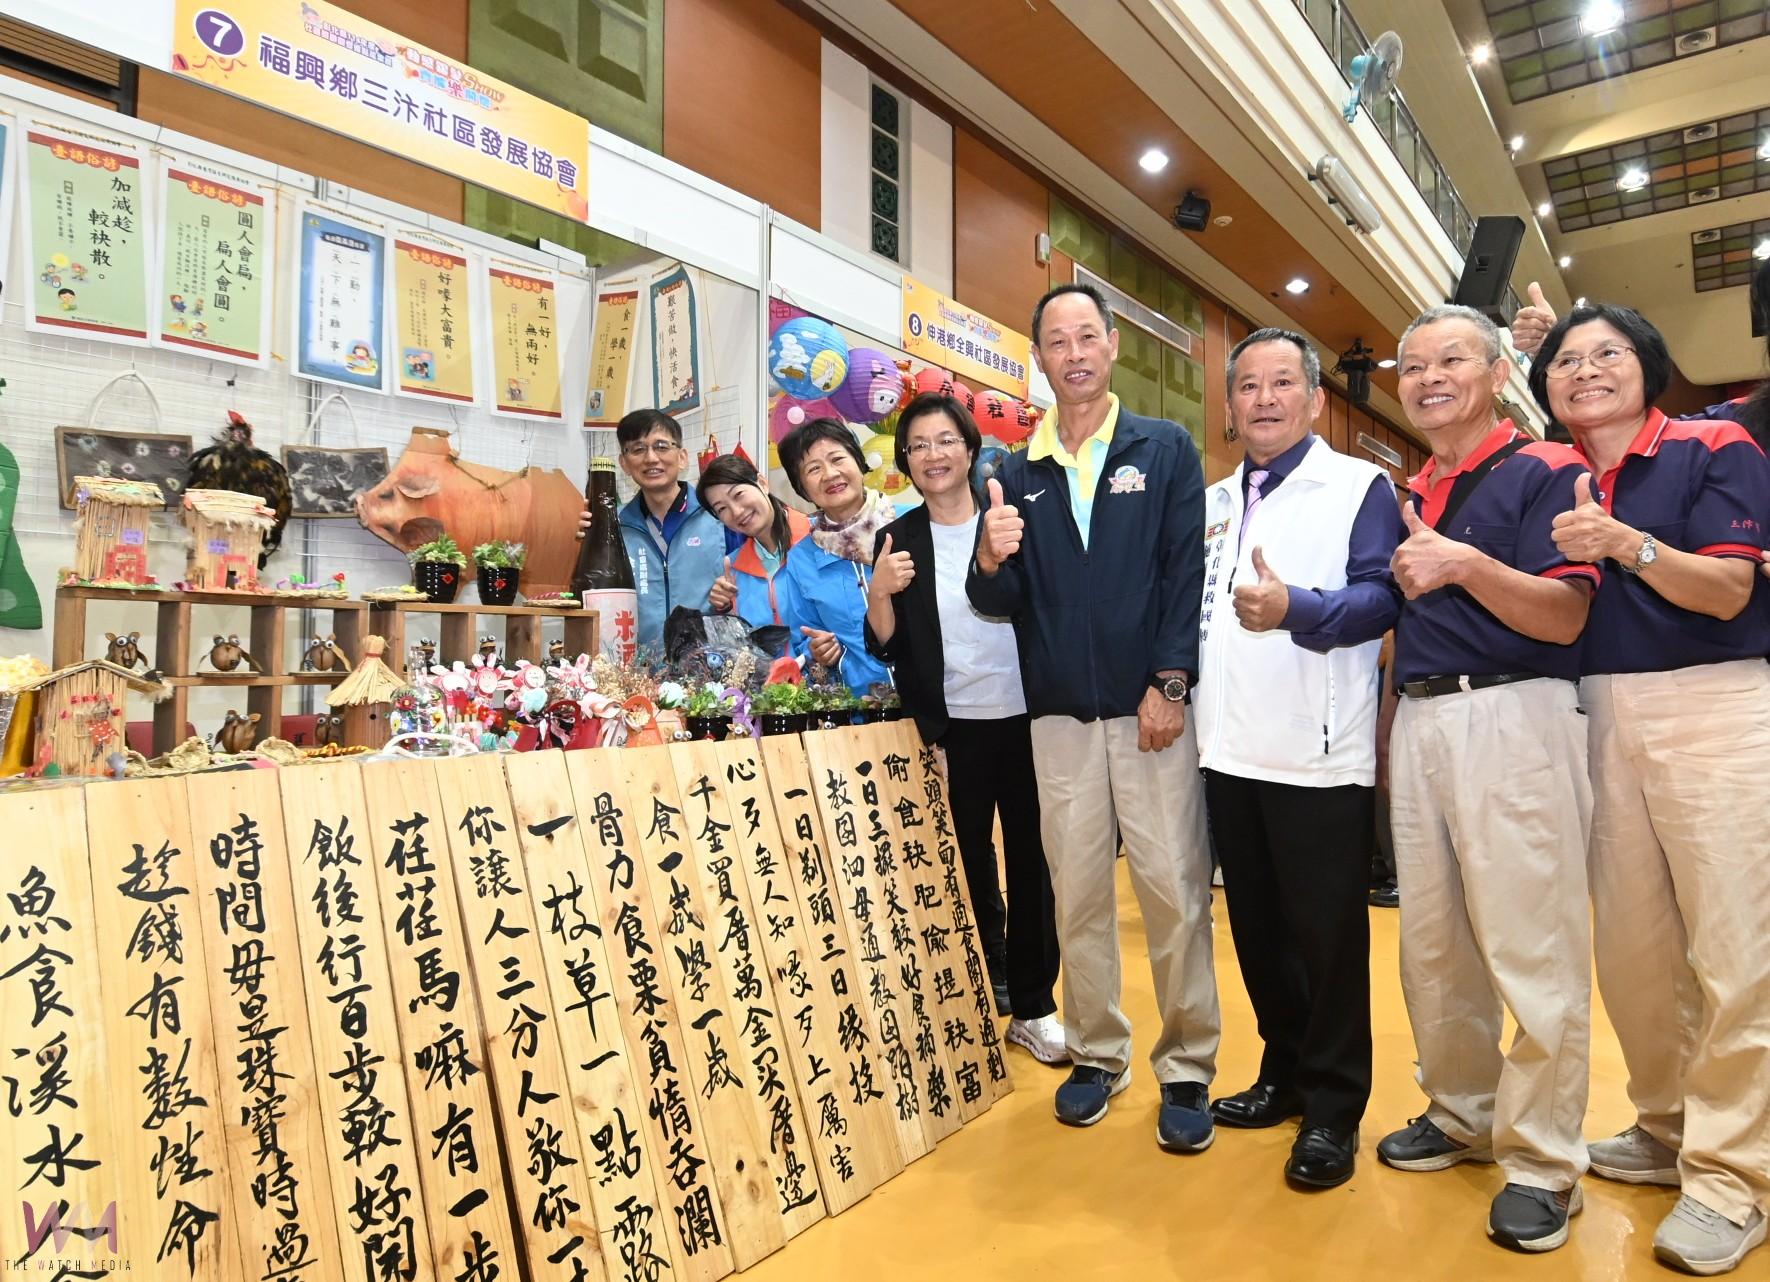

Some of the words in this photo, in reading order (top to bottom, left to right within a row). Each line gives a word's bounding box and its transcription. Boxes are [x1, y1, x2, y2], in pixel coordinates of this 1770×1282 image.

[209, 17, 232, 46] 7
[259, 36, 577, 188] 福興鄉三汴社區發展協會
[911, 316, 920, 333] 8
[0, 866, 110, 1282] 魚食溪水人
[210, 813, 318, 1282] 時間毋是珠寶時過
[528, 815, 670, 1282] 一枝草一點露
